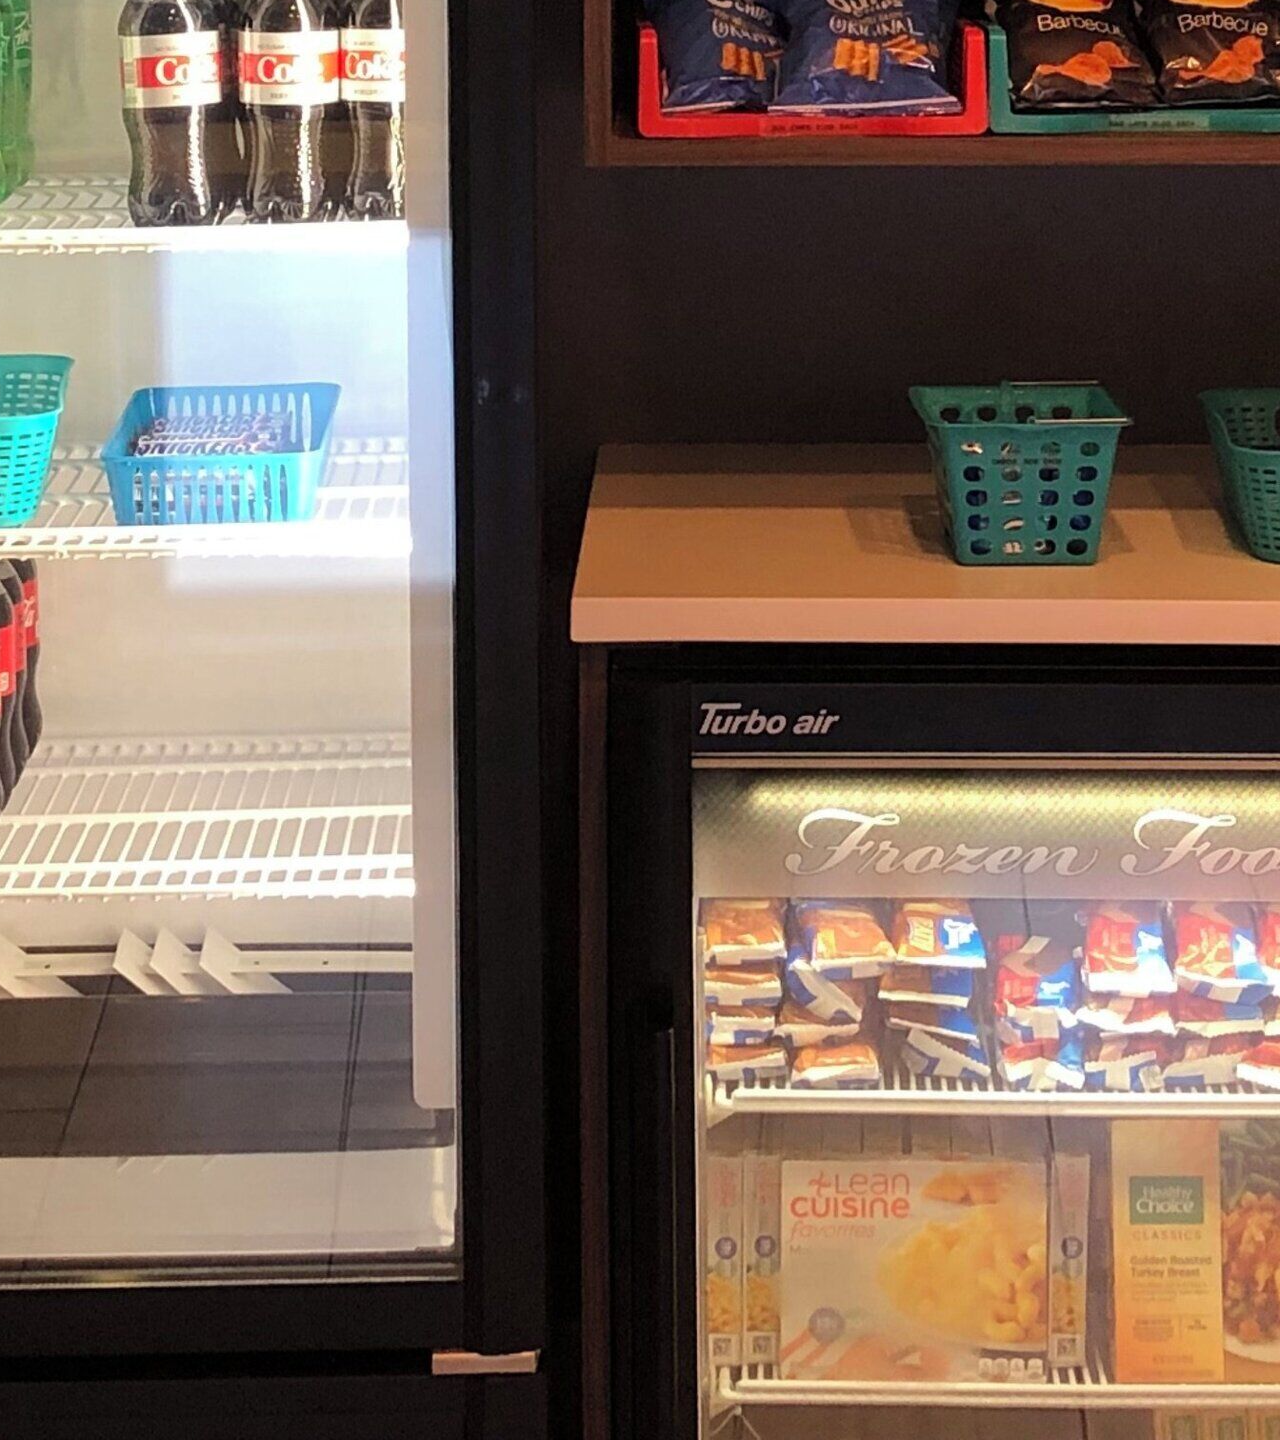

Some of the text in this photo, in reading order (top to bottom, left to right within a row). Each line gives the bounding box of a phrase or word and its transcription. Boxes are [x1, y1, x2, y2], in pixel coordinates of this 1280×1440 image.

[1177, 11, 1269, 36] Barbecue
[698, 701, 840, 735] Turbo air
[783, 808, 1099, 878] Frozen
[835, 1172, 911, 1195] Lean
[1135, 1199, 1195, 1214] Choice
